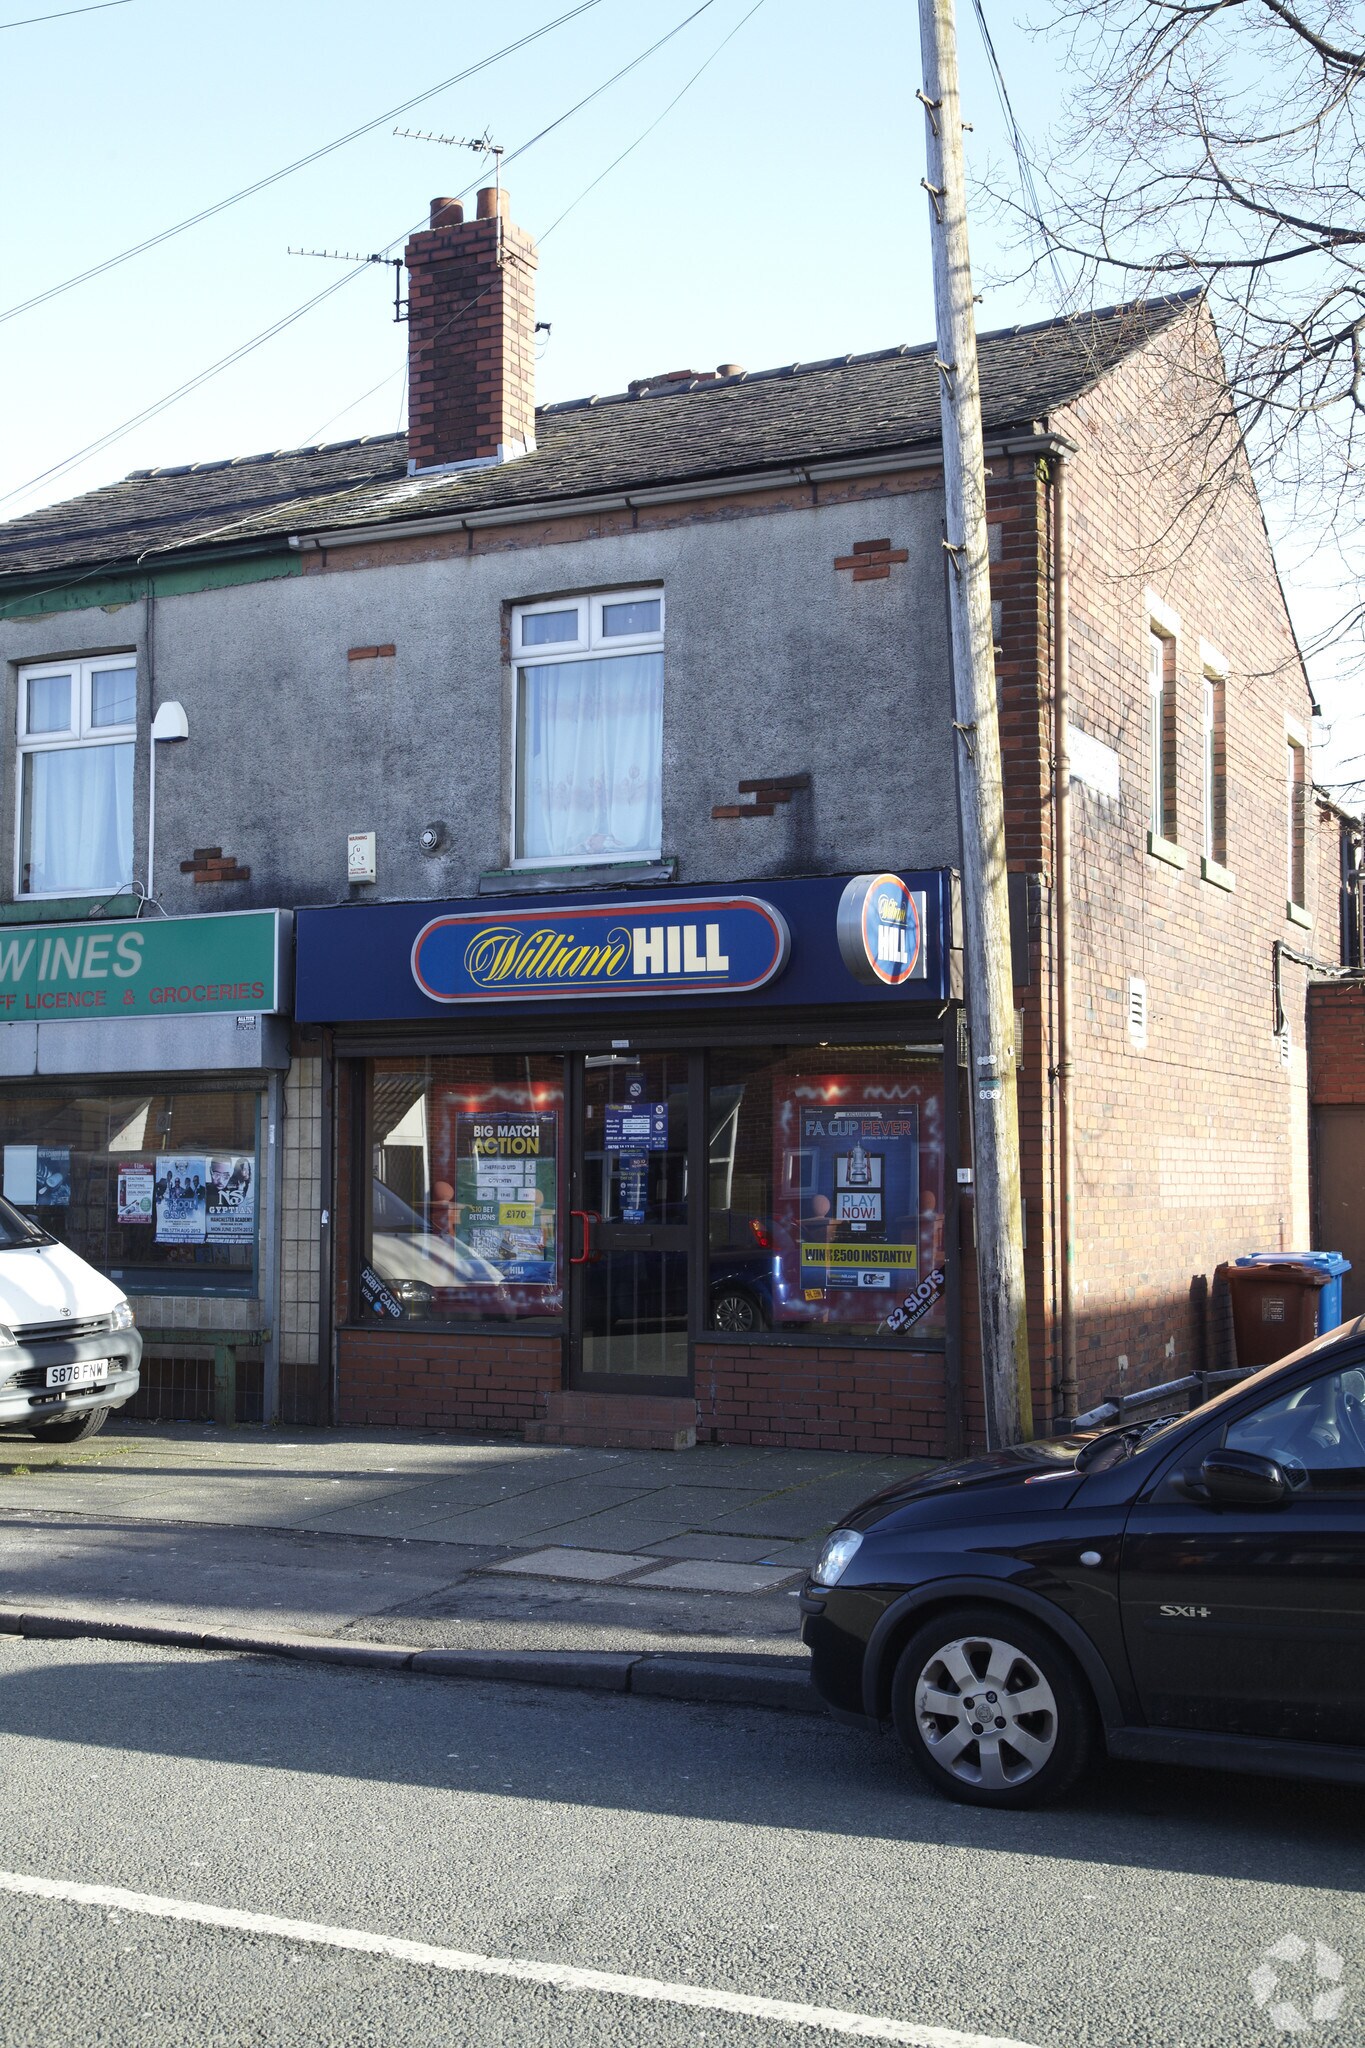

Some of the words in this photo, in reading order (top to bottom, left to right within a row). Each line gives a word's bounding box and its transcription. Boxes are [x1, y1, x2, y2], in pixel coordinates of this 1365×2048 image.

[877, 924, 908, 964] HILL
[0, 931, 144, 982] WINES
[464, 927, 633, 983] William
[633, 924, 729, 975] HILL
[25, 990, 106, 1010] LICENCE
[122, 989, 135, 1005] &
[150, 982, 265, 1004] GROCERIES
[473, 1125, 494, 1137] BIG
[497, 1125, 539, 1137] MATCH
[805, 1120, 826, 1136] FA
[827, 1120, 859, 1136] CUP
[861, 1120, 911, 1136] FEVER
[472, 1137, 540, 1154] ACTION
[842, 1195, 876, 1207] PLAY
[208, 1206, 253, 1214] GYPTIAN
[506, 1210, 526, 1219] £170
[842, 1207, 876, 1219] NOW!
[805, 1248, 825, 1261] WIN
[833, 1249, 859, 1263] £500
[861, 1250, 912, 1263] INSTANTLY
[509, 1266, 525, 1275] HILL
[361, 1269, 382, 1294] DEBIT
[379, 1292, 401, 1318] CARD
[361, 1286, 374, 1302] VISA
[886, 1306, 908, 1331] £2
[904, 1269, 945, 1313] SLOTS
[903, 1305, 929, 1330] AVAILABLE
[927, 1291, 941, 1306] HERE
[51, 1366, 80, 1383] S878
[83, 1363, 103, 1378] FNW
[1160, 1605, 1211, 1617] SXi+
